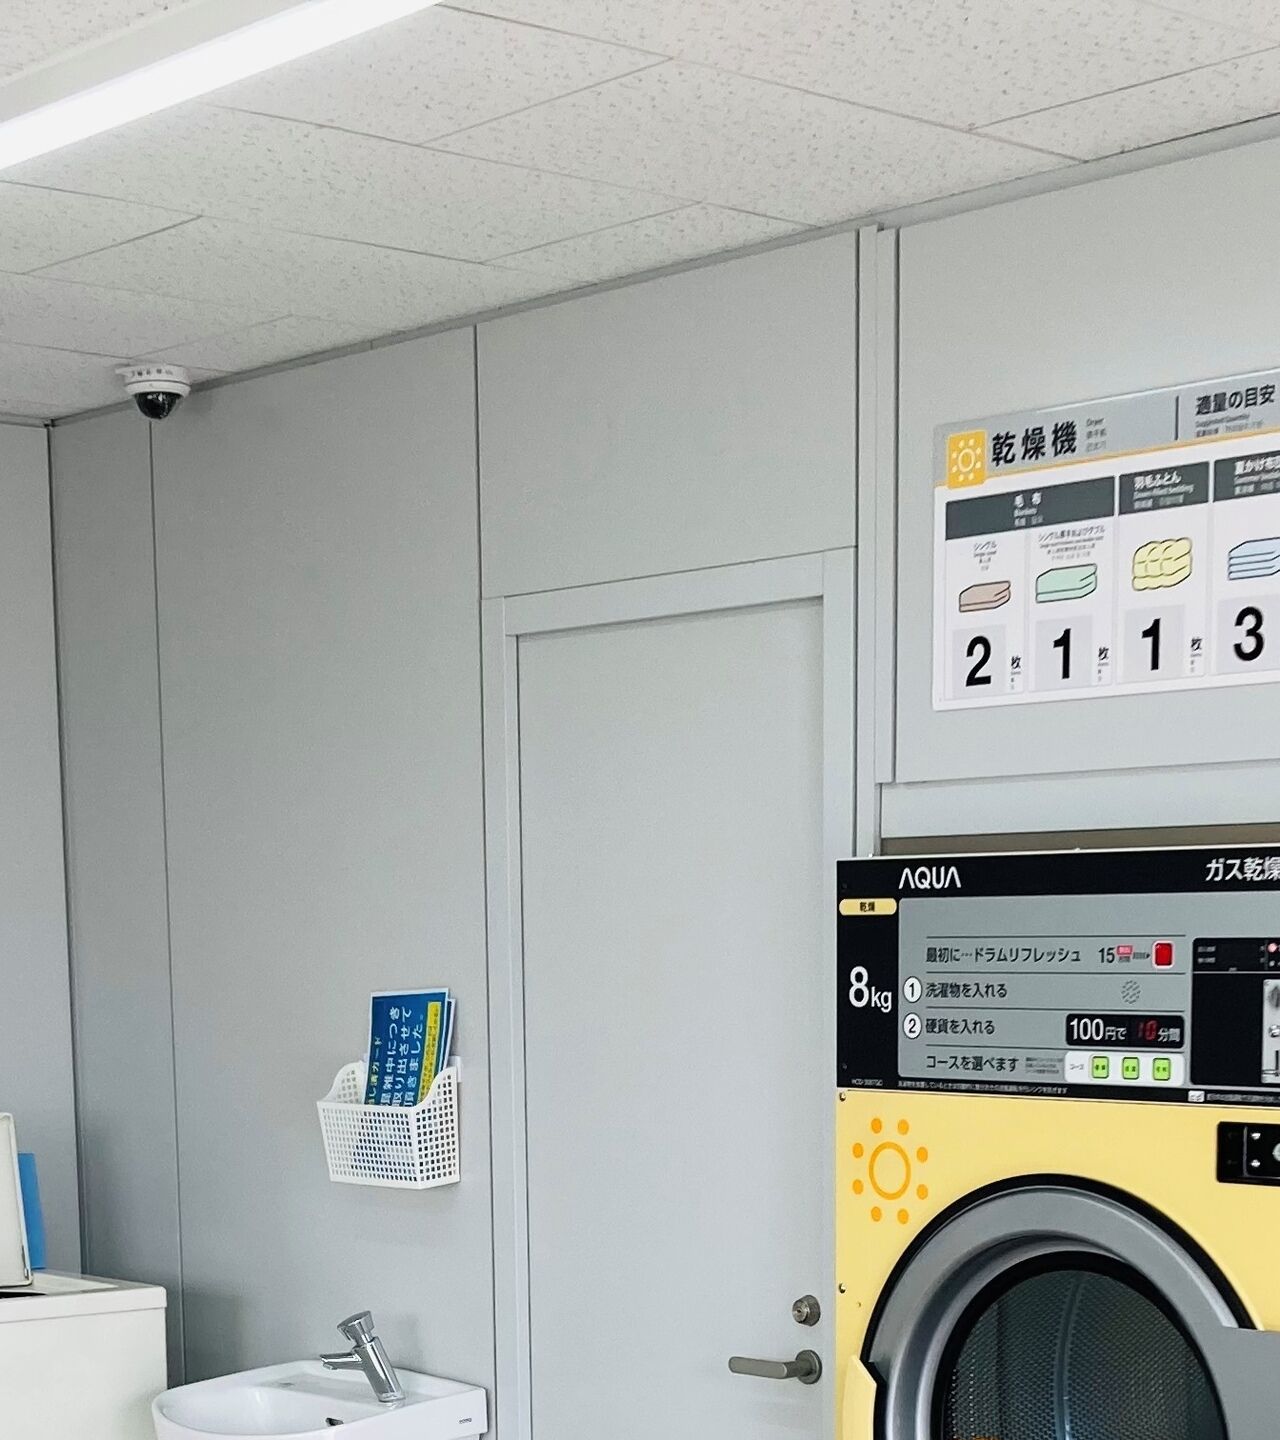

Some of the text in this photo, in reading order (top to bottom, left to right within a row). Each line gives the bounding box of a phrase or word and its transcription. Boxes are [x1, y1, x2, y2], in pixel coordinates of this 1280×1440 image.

[992, 420, 1077, 467] 乾燥機
[1195, 384, 1276, 416] 適量の目安
[1053, 628, 1071, 679] 1
[1142, 618, 1161, 671] 1
[1234, 606, 1263, 661] 3
[966, 635, 991, 687] 2
[899, 866, 961, 889] AQUA
[1099, 948, 1115, 963] 15
[849, 966, 892, 1013] 8kg
[926, 983, 1007, 998] 洗濯物を入れる
[926, 1018, 995, 1034] 硬貨を入れる
[926, 1055, 1019, 1072] コースを選べます
